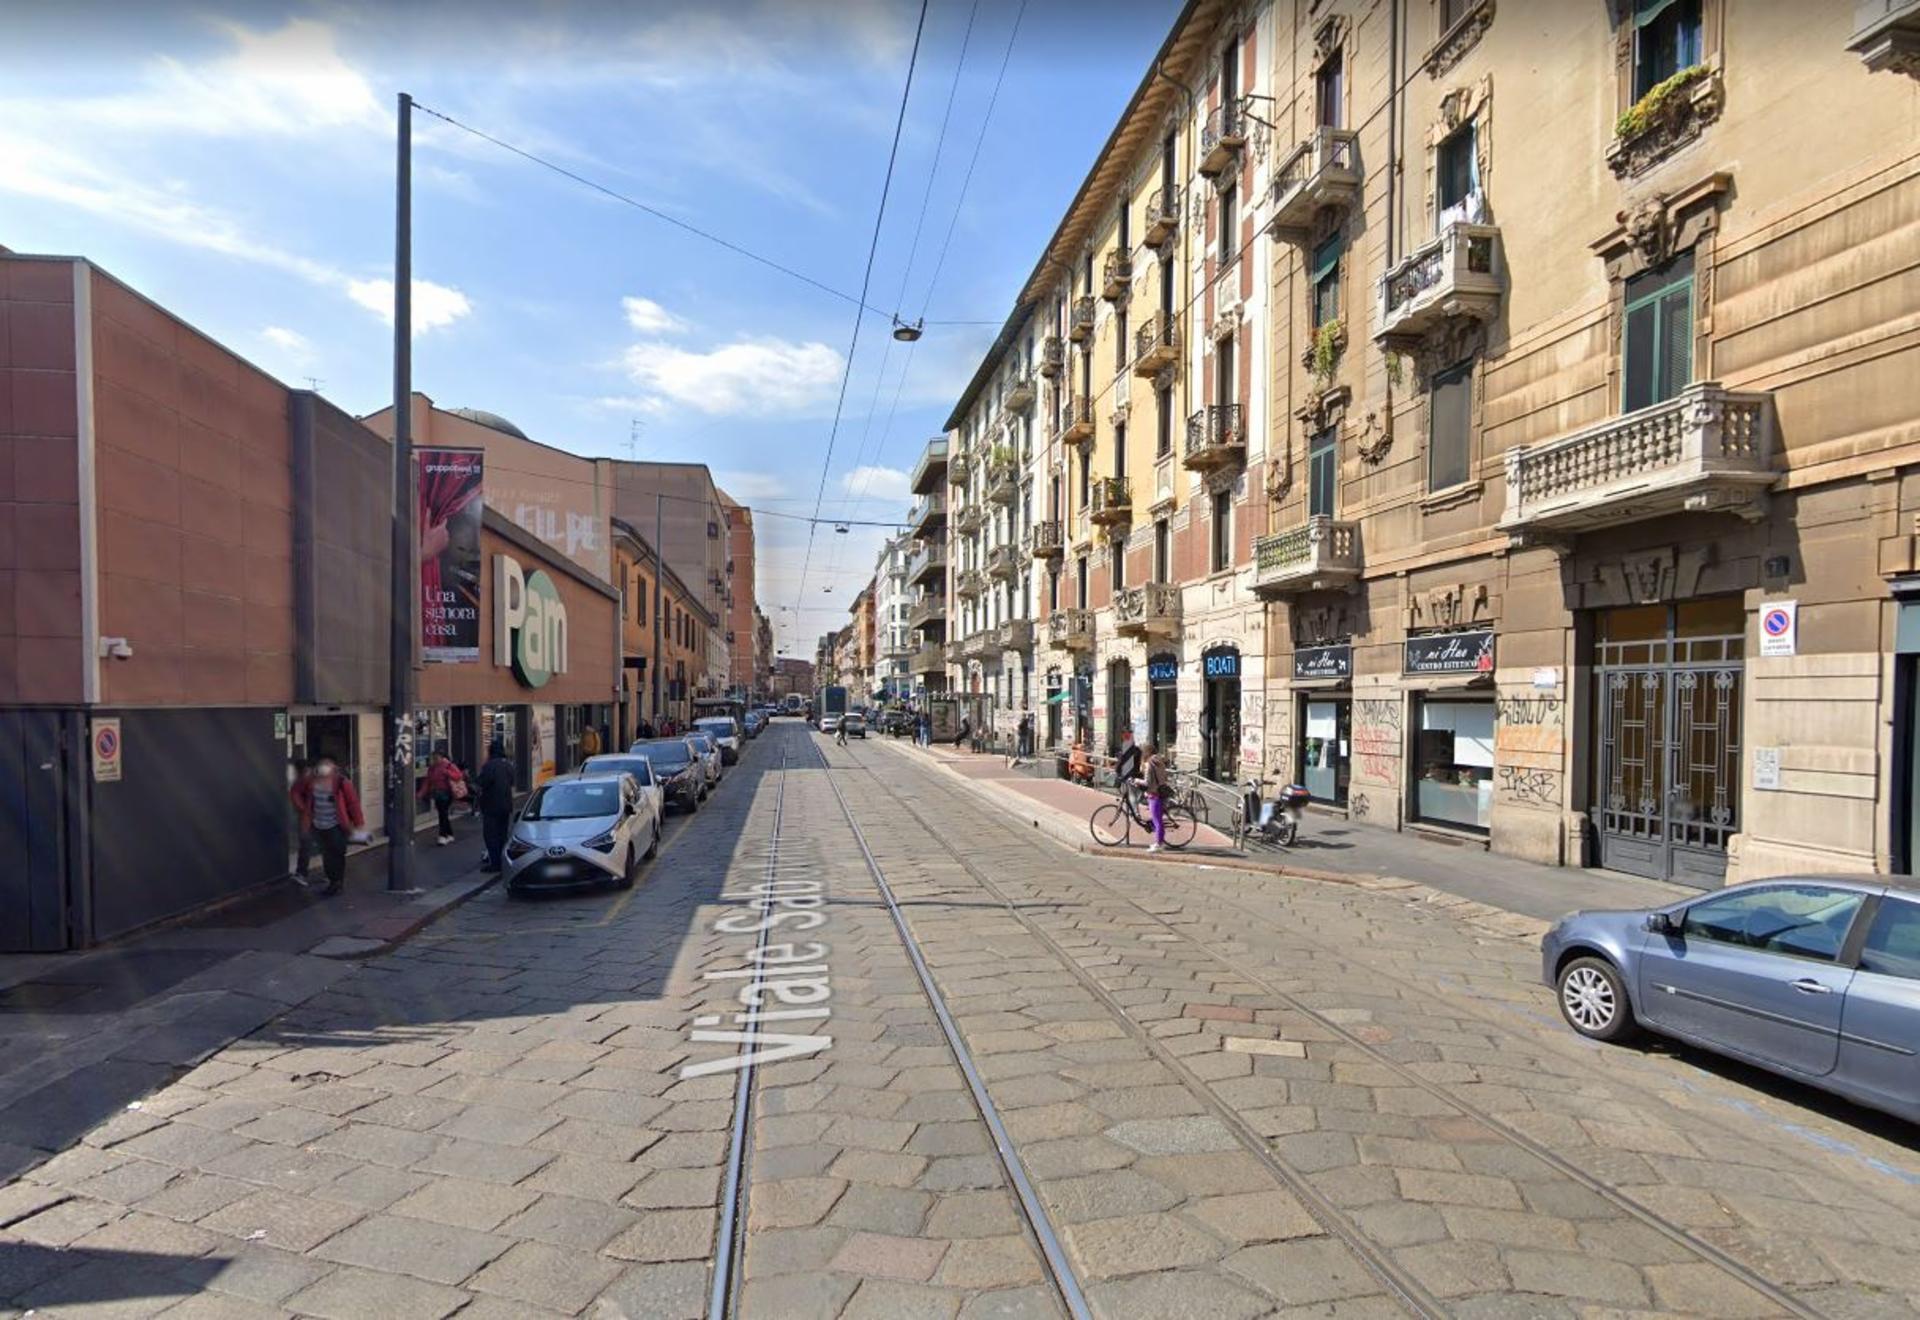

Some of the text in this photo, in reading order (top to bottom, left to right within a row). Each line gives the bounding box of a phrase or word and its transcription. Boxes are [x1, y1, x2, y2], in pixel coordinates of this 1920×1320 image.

[426, 586, 456, 602] Una
[425, 603, 475, 623] signora
[493, 554, 567, 675] Pam
[426, 624, 457, 636] casa
[1207, 656, 1236, 674] BOATI
[1417, 660, 1477, 671] CENTRO ESTETICO
